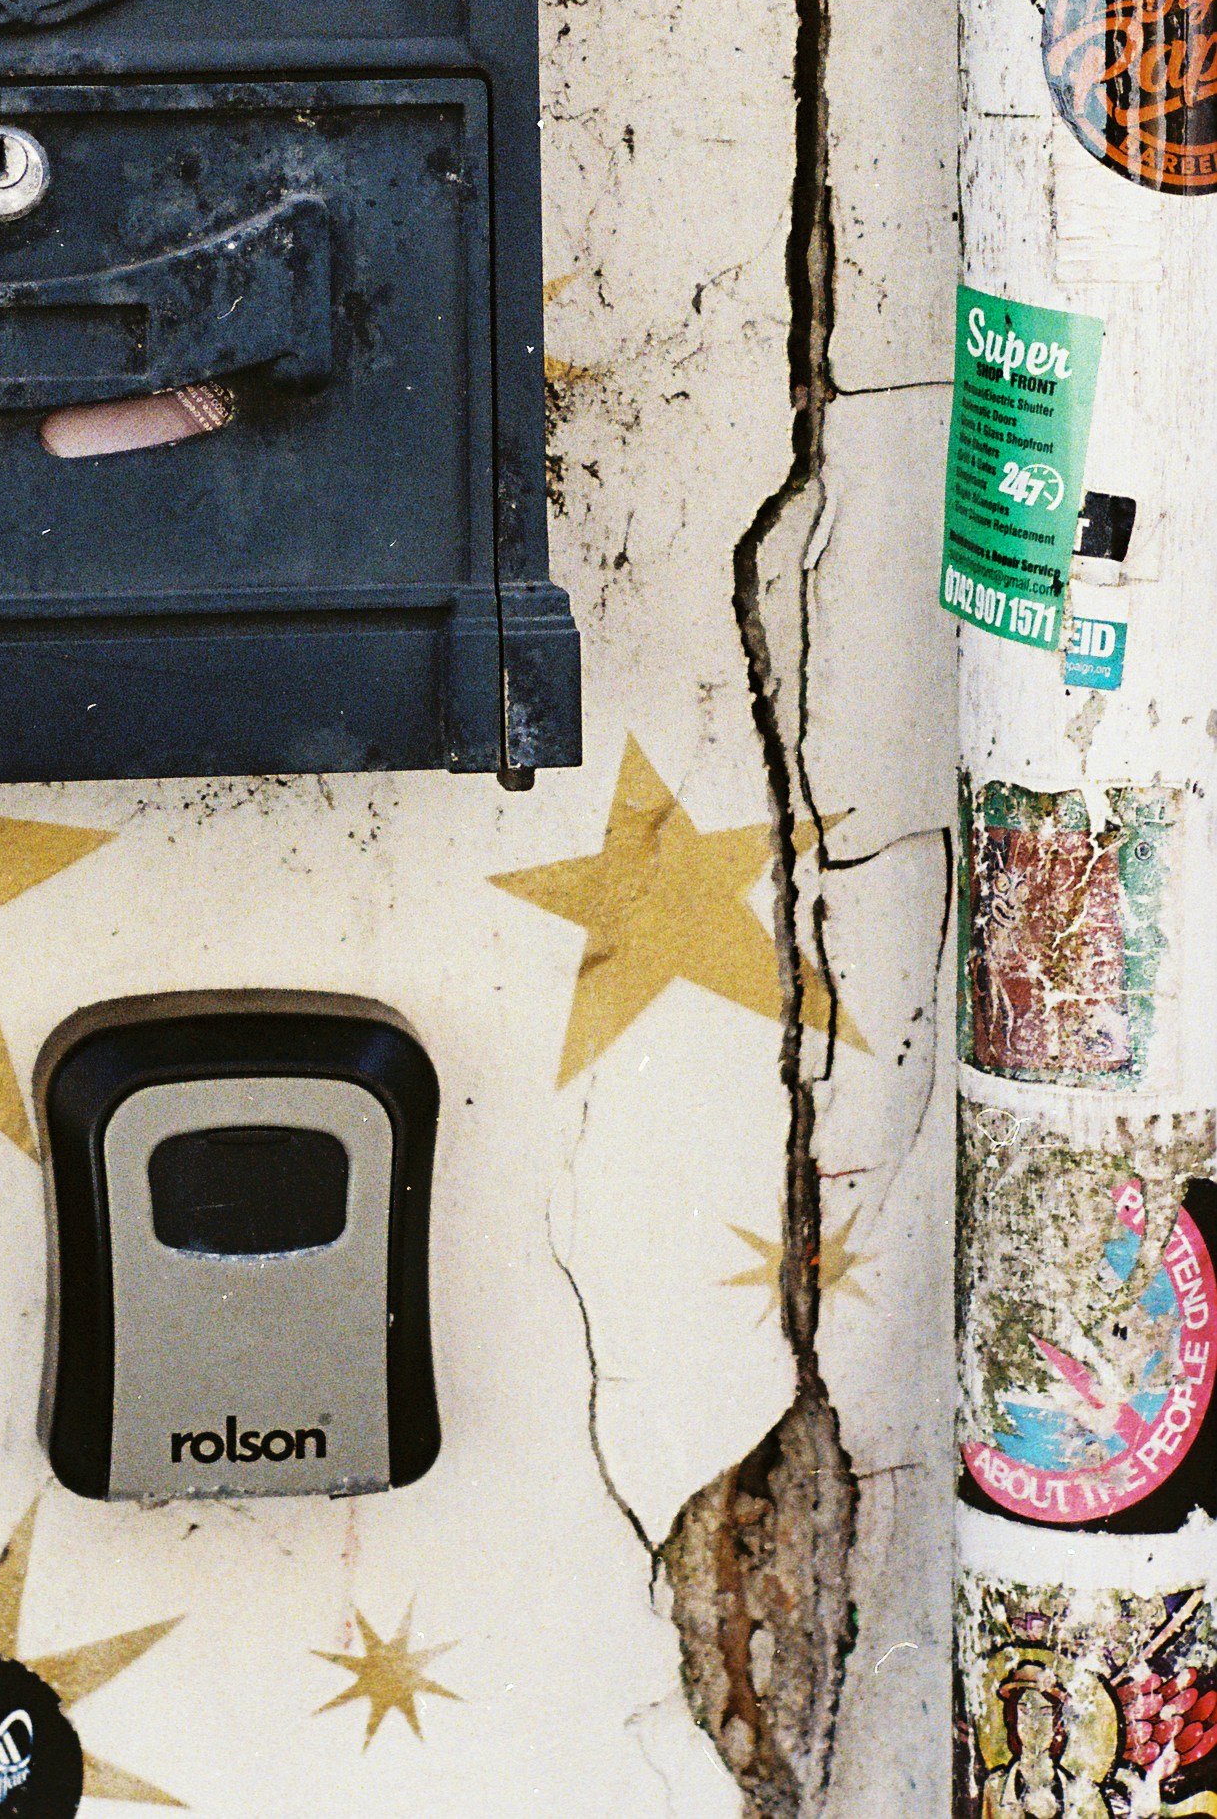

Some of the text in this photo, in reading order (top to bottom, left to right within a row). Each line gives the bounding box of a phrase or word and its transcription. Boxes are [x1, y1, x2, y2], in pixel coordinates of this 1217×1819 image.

[966, 307, 1073, 381] Super
[976, 361, 1058, 396] SHOP FRONT
[992, 408, 1018, 428] Doors
[1017, 397, 1055, 418] Shutter
[1006, 431, 1055, 455] Shopfront
[992, 517, 1056, 546] Replacement
[1020, 558, 1062, 579] Service
[974, 583, 1007, 628] 907
[1008, 596, 1057, 643] 1571
[1136, 1341, 1210, 1474] PEOPLE
[170, 1414, 327, 1464] rolson
[973, 1448, 1073, 1514] ABOUT
